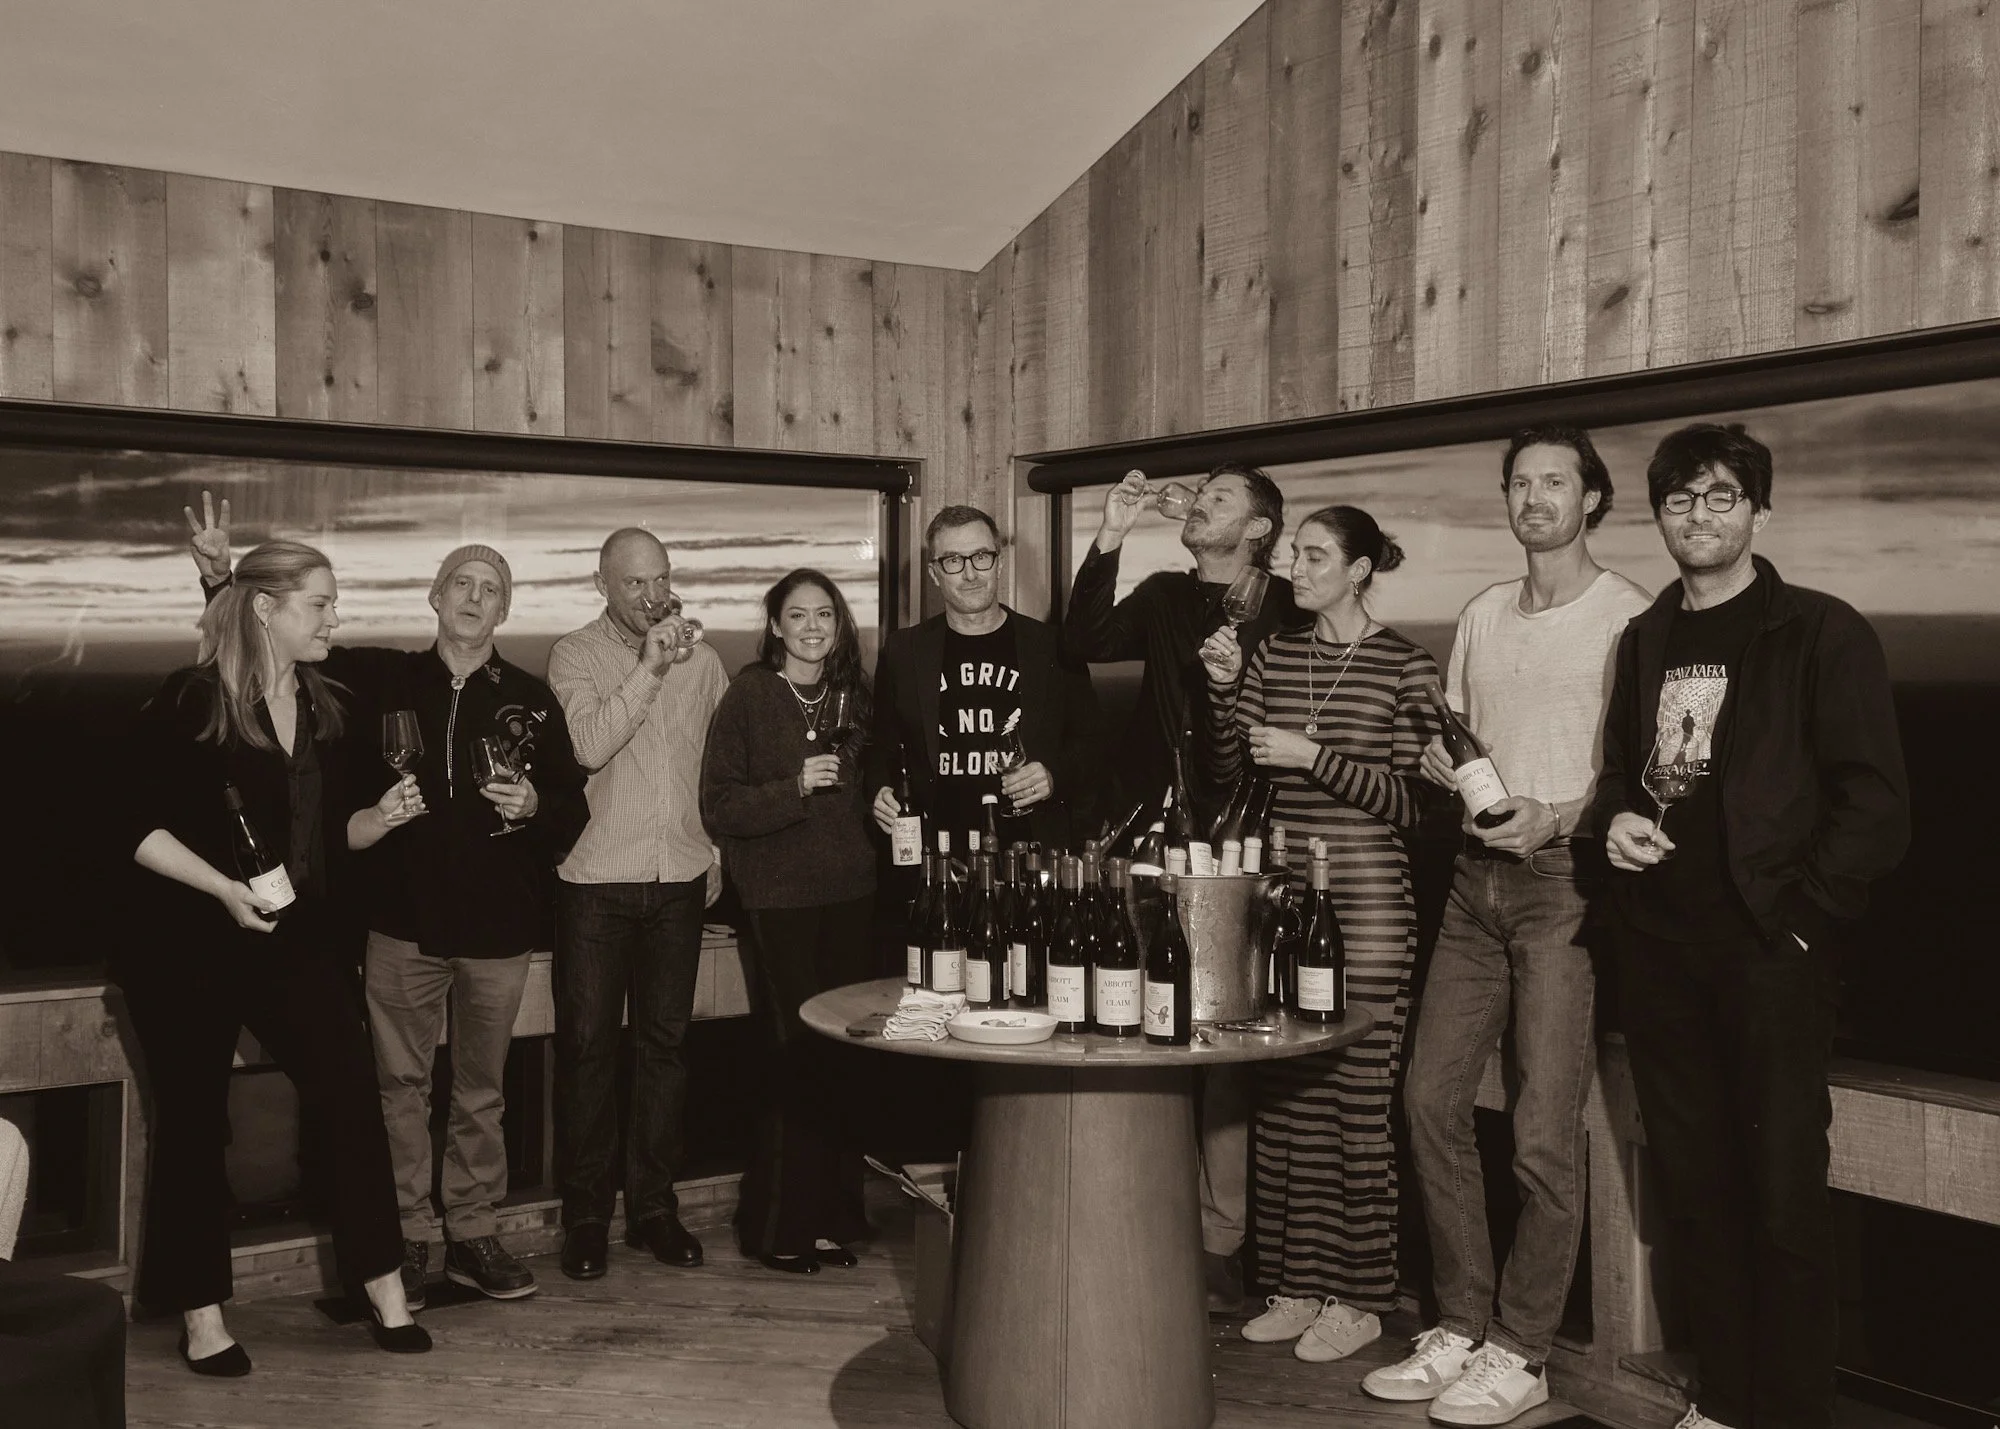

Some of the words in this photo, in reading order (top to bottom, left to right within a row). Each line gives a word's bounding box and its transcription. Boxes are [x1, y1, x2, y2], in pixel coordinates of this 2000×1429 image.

[960, 662, 1020, 692] GRIT
[1692, 664, 1727, 678] KAFKA
[958, 708, 994, 734] NO
[939, 751, 1015, 776] GLORY
[1104, 980, 1133, 988] ABBOTT
[1105, 999, 1131, 1007] CLAIM
